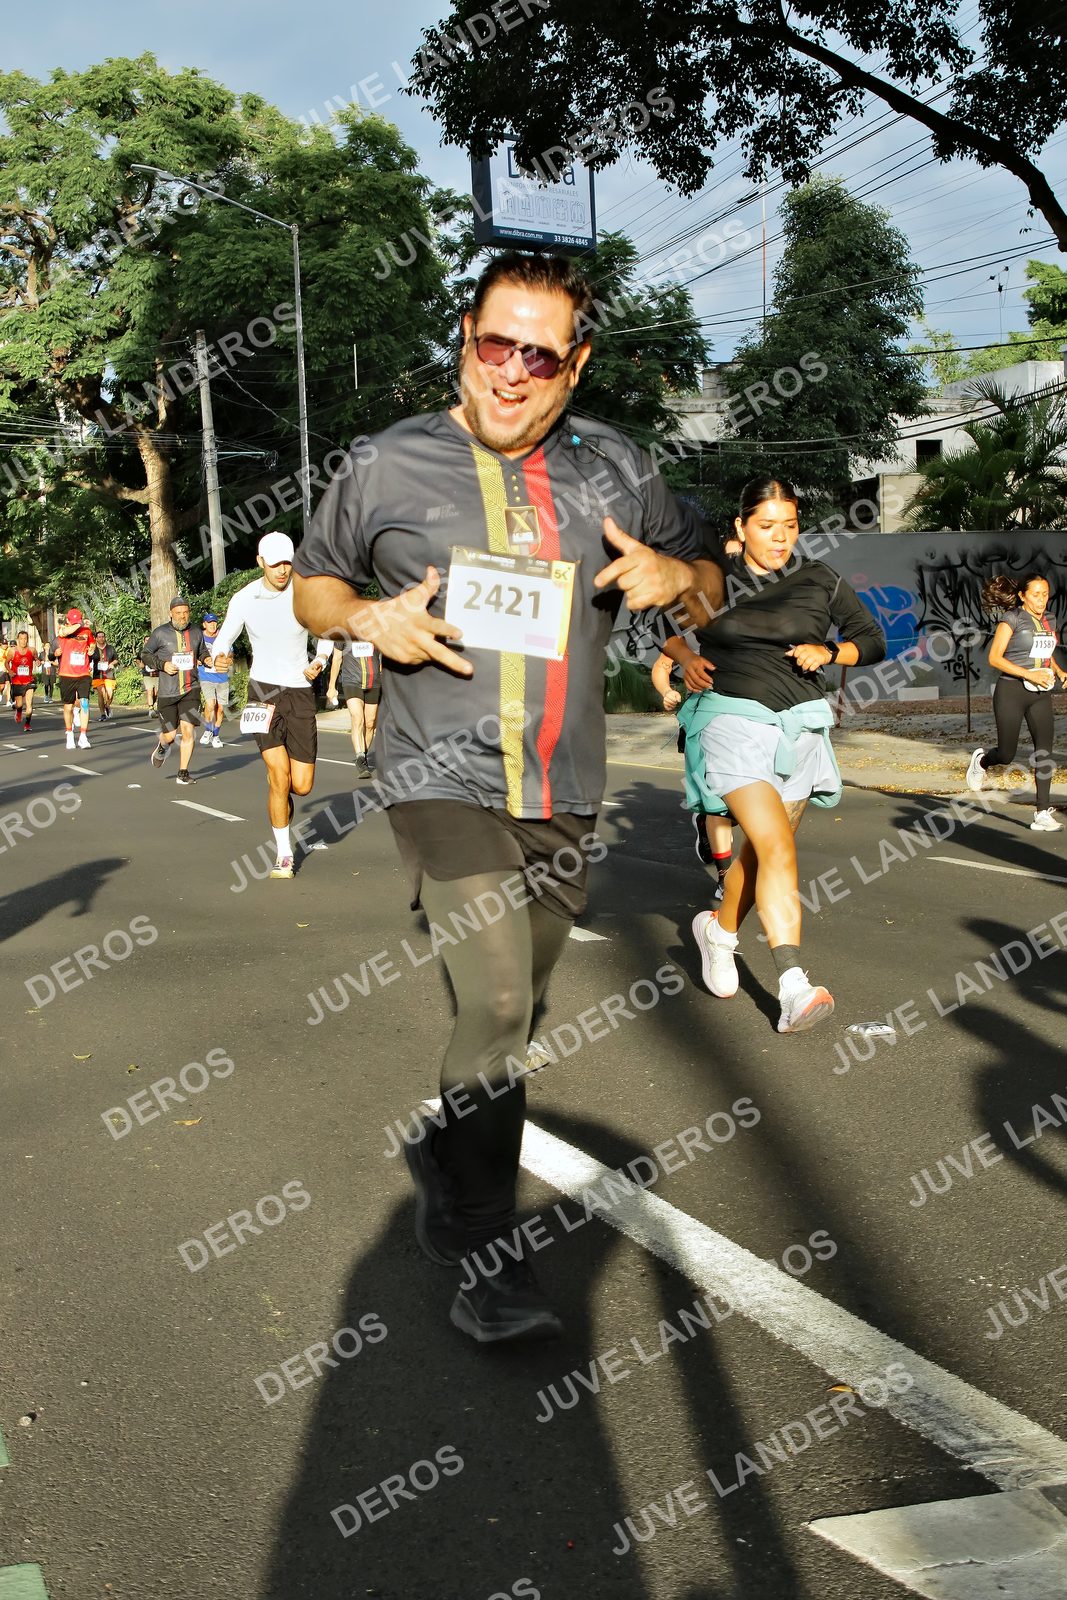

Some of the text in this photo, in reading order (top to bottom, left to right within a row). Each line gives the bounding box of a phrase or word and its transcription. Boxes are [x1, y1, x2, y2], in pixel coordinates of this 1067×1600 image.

[554, 235, 562, 243] 33
[463, 580, 541, 620] 2421
[243, 712, 267, 722] 10769
